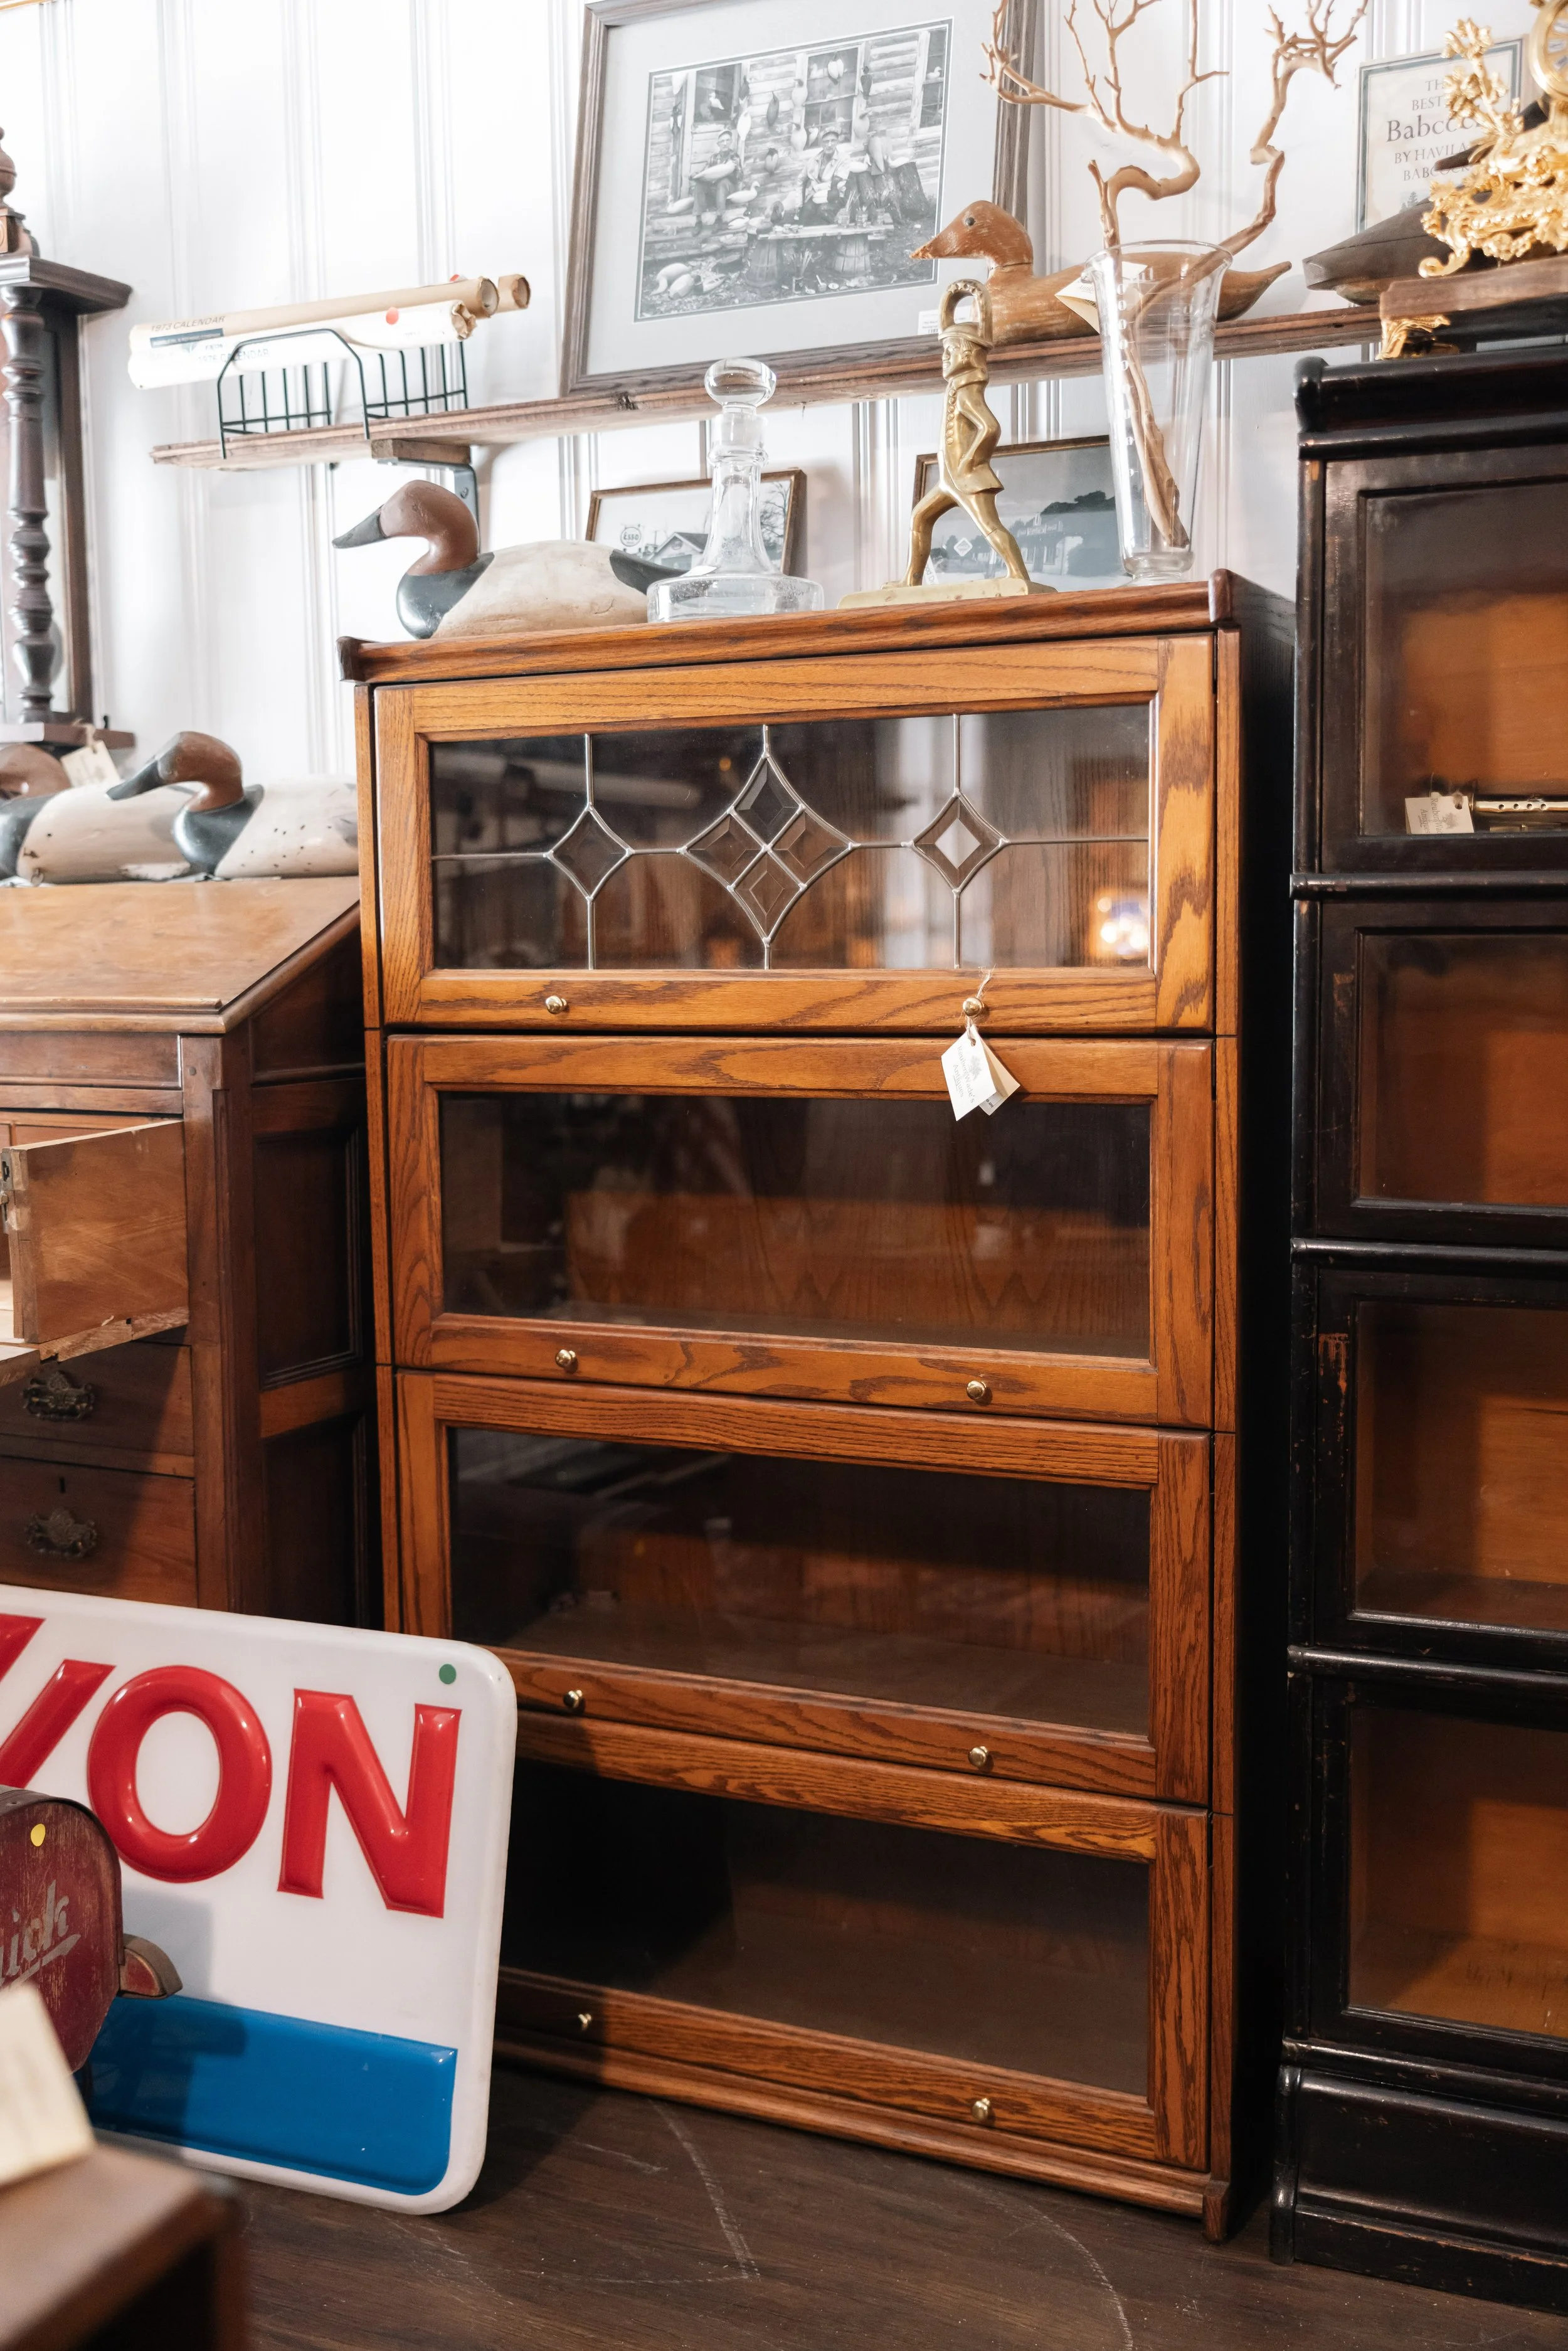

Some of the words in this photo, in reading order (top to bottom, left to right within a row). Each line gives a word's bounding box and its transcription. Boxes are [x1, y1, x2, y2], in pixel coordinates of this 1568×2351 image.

[1425, 78, 1446, 92] TH
[1412, 95, 1444, 111] BEST
[1394, 150, 1411, 164] BY
[1414, 142, 1466, 161] HAVILA
[151, 323, 172, 332] 1973
[173, 316, 226, 329] CALENDAR
[1420, 809, 1431, 834] Antiques
[953, 1064, 965, 1098] Antiques
[965, 1071, 975, 1103] Wade's
